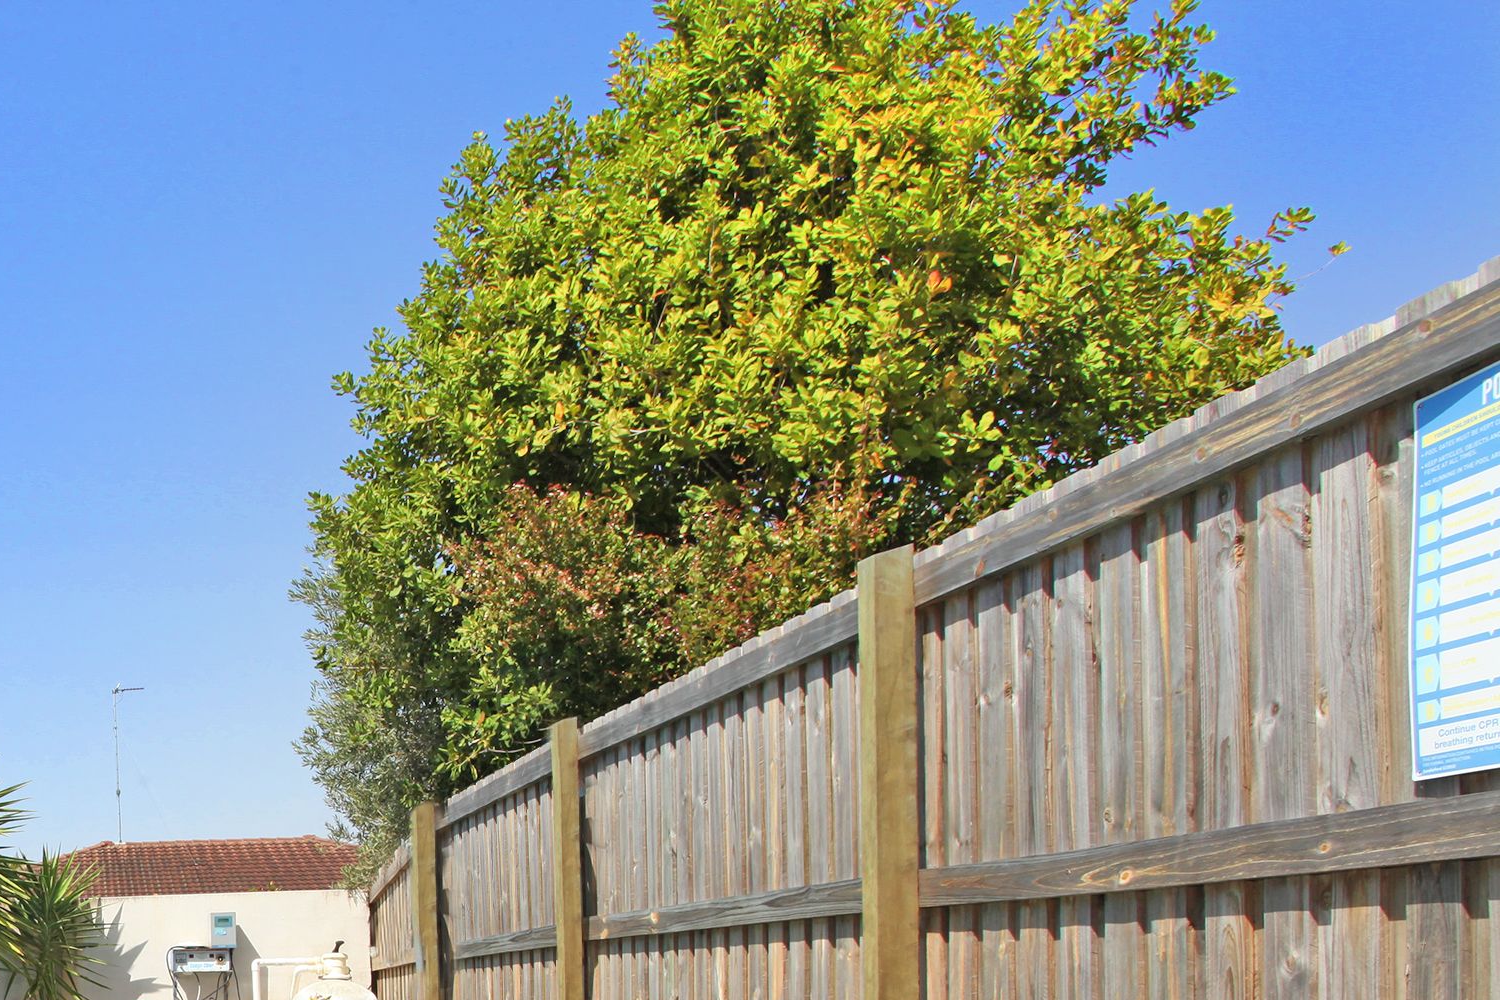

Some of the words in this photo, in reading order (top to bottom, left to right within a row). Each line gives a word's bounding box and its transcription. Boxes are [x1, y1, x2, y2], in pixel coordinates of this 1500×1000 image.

[1438, 724, 1476, 737] Continue
[1478, 718, 1499, 729] CPR
[1434, 736, 1473, 749] breathing
